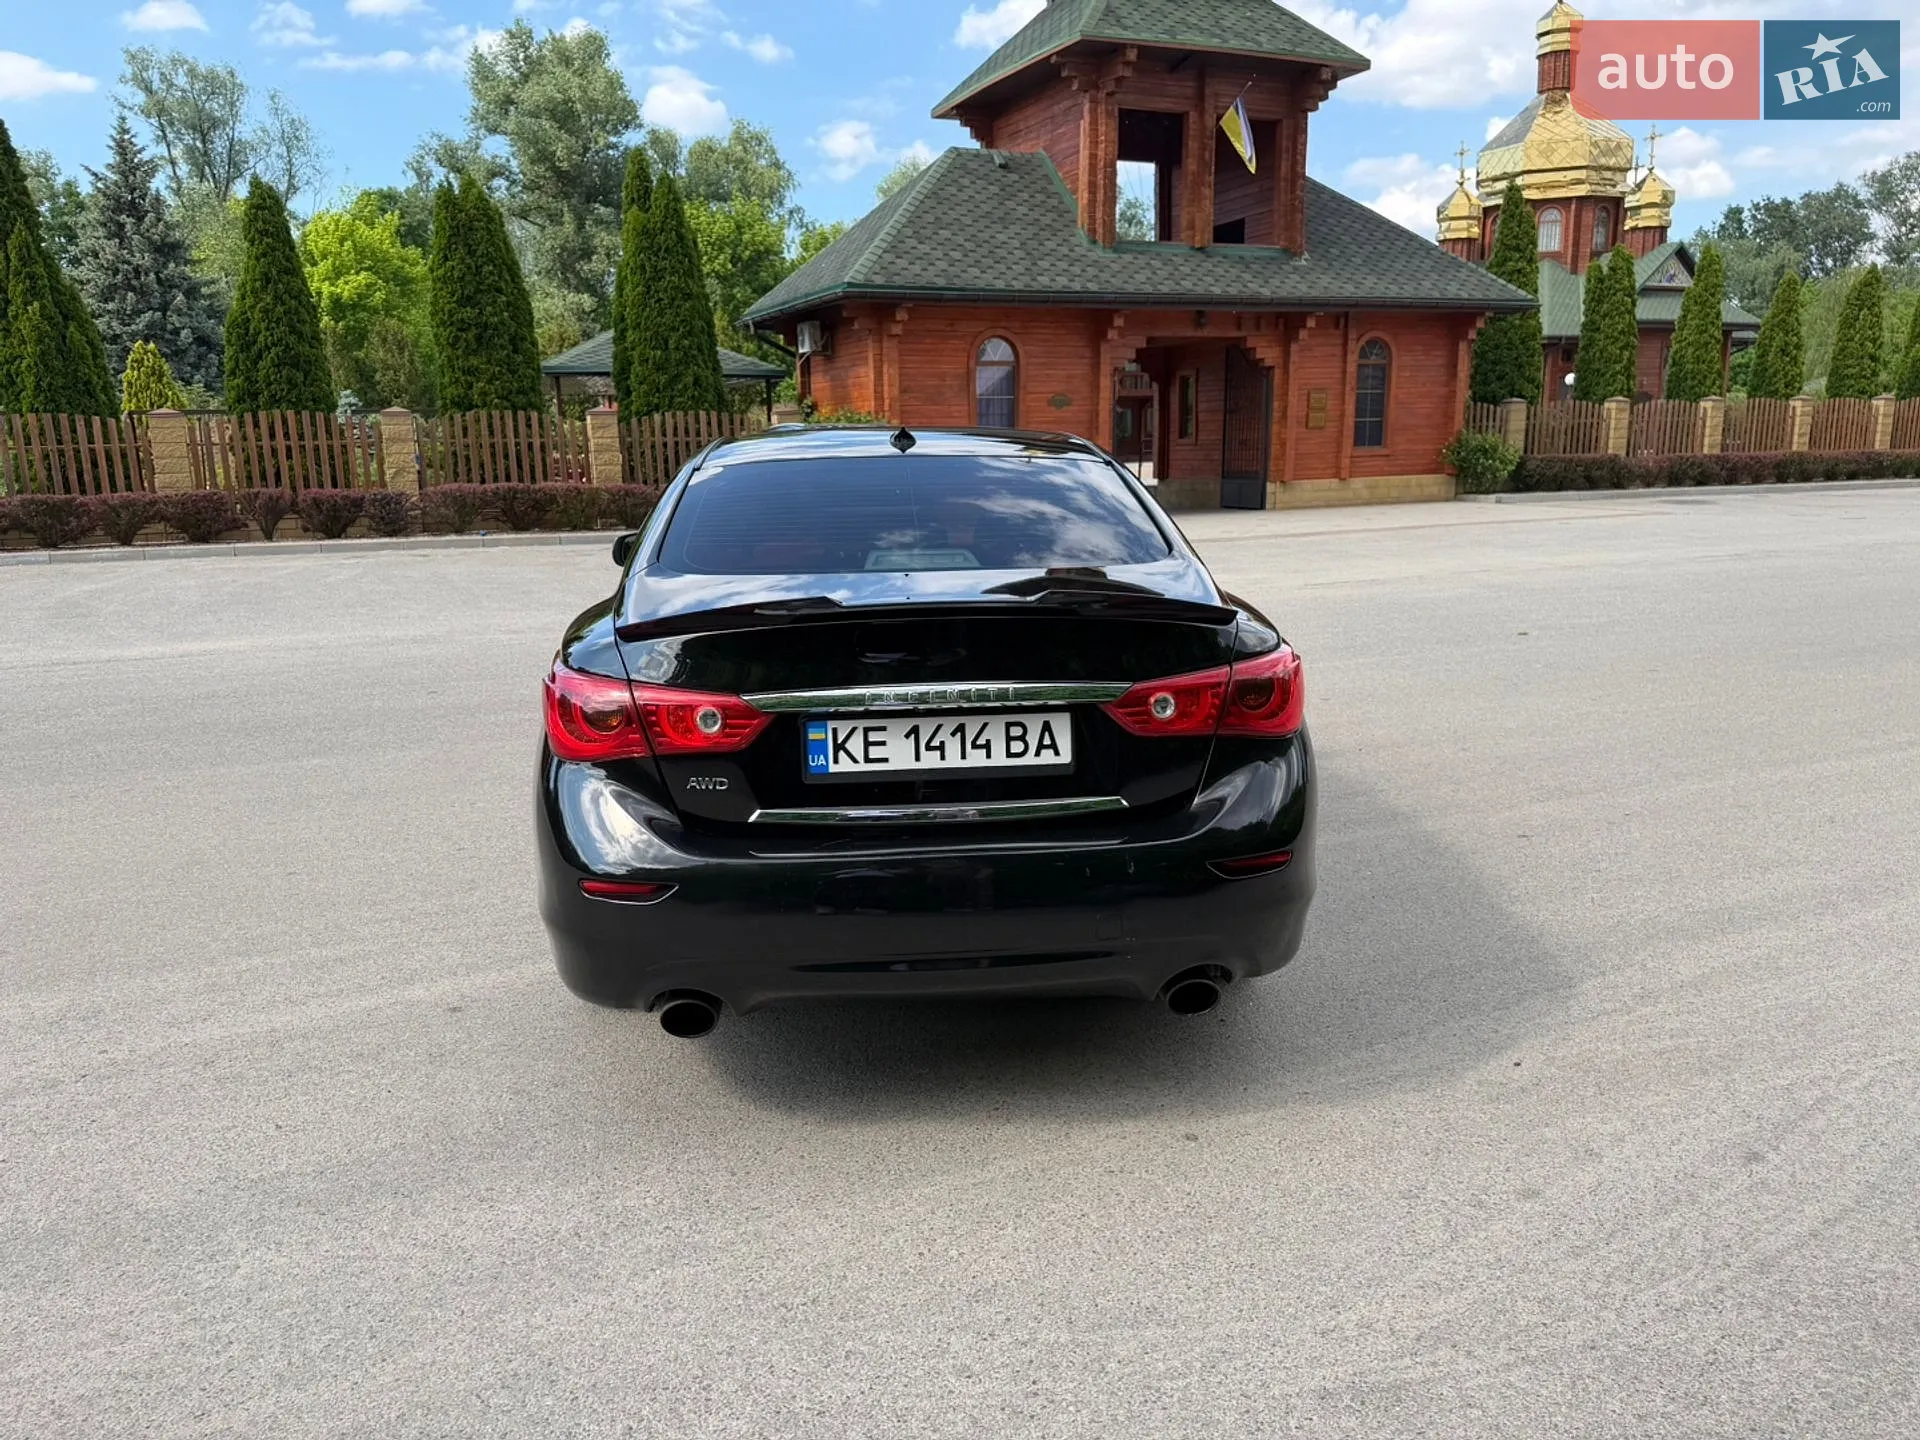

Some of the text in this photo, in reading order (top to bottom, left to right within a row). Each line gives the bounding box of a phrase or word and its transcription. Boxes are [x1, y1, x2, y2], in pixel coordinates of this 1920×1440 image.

[865, 686, 1015, 705] INFINITI
[831, 719, 1062, 765] KE 1414 BA
[808, 754, 827, 767] UA
[686, 777, 729, 791] AWD
